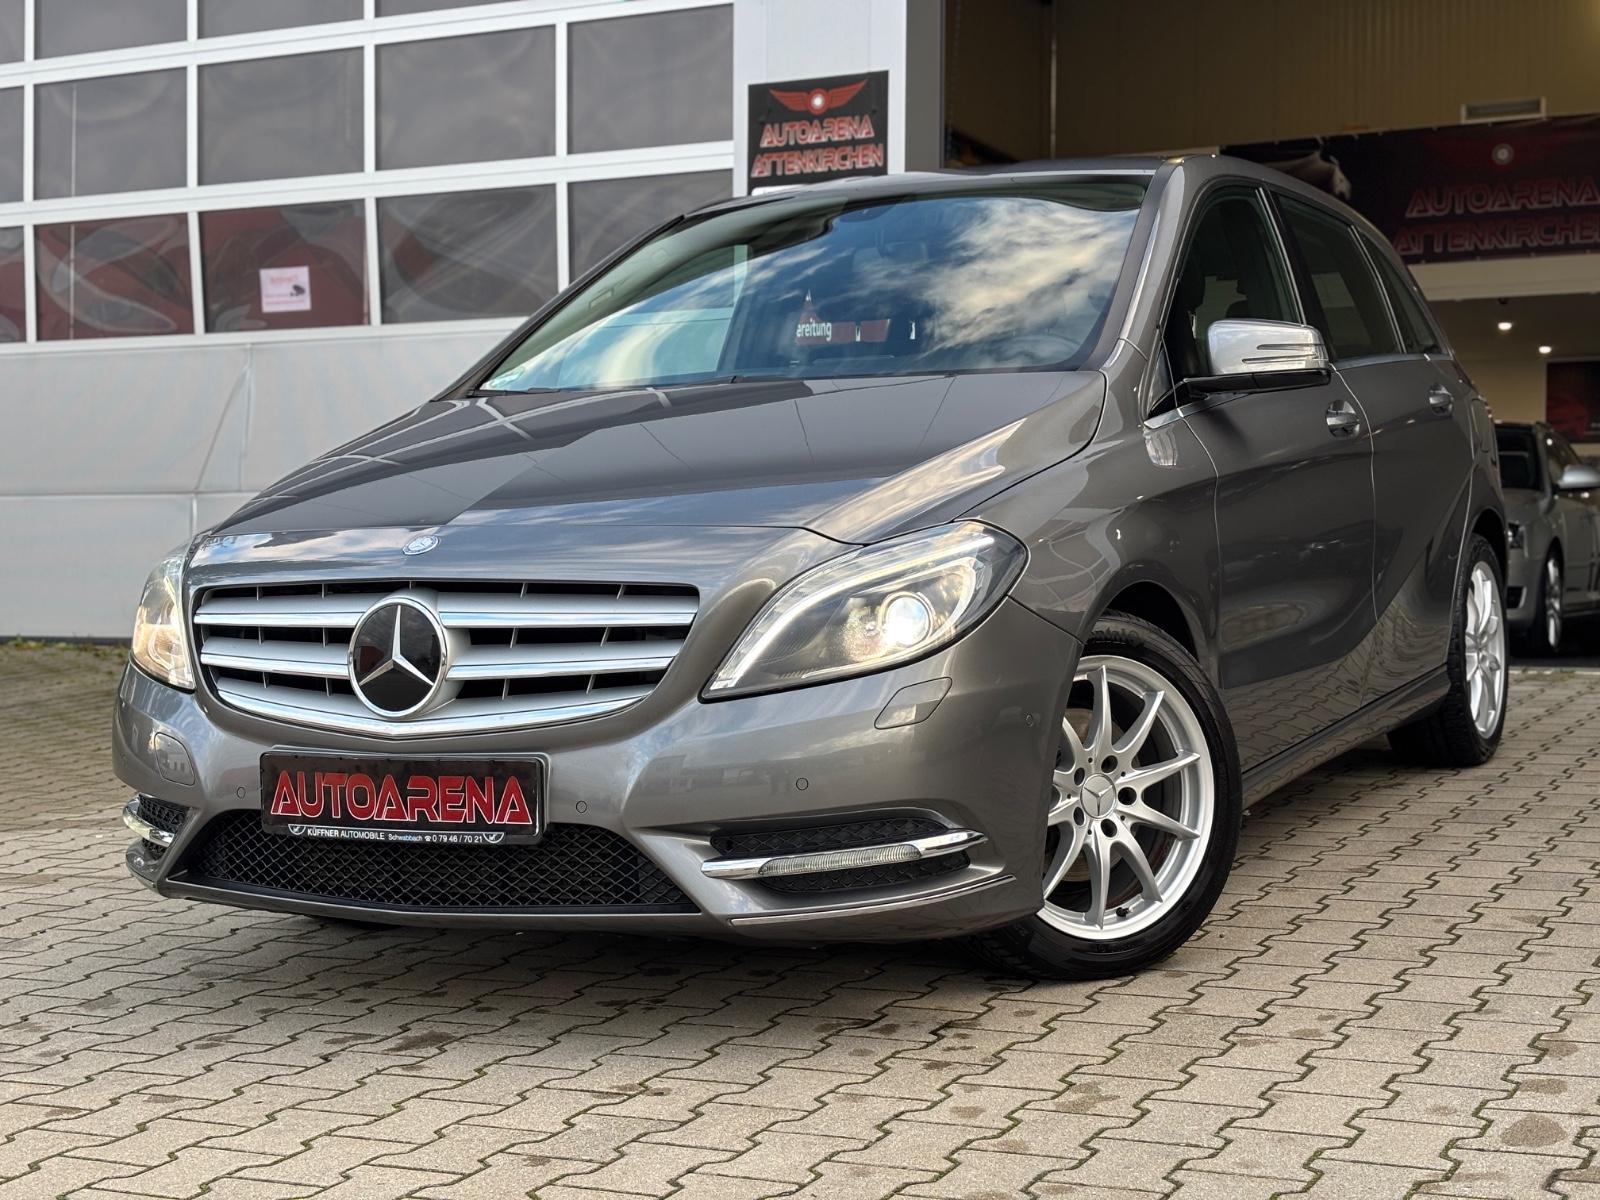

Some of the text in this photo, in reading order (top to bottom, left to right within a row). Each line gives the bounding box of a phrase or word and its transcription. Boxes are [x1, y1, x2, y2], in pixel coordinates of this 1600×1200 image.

[760, 114, 875, 148] AUTOARENA
[750, 143, 884, 178] ATTENKIRCHEN
[1404, 175, 1600, 218] AUTOARENA
[1392, 212, 1600, 256] ATTENKIRCHE
[271, 770, 532, 824] AUTOARENA
[307, 827, 339, 838] KÜFFNER
[340, 830, 385, 840] AUTOMOBILE
[388, 832, 423, 842] Schwabbach
[432, 834, 438, 843] 0
[439, 834, 448, 843] 79
[463, 835, 473, 843] 70
[474, 835, 483, 844] 21
